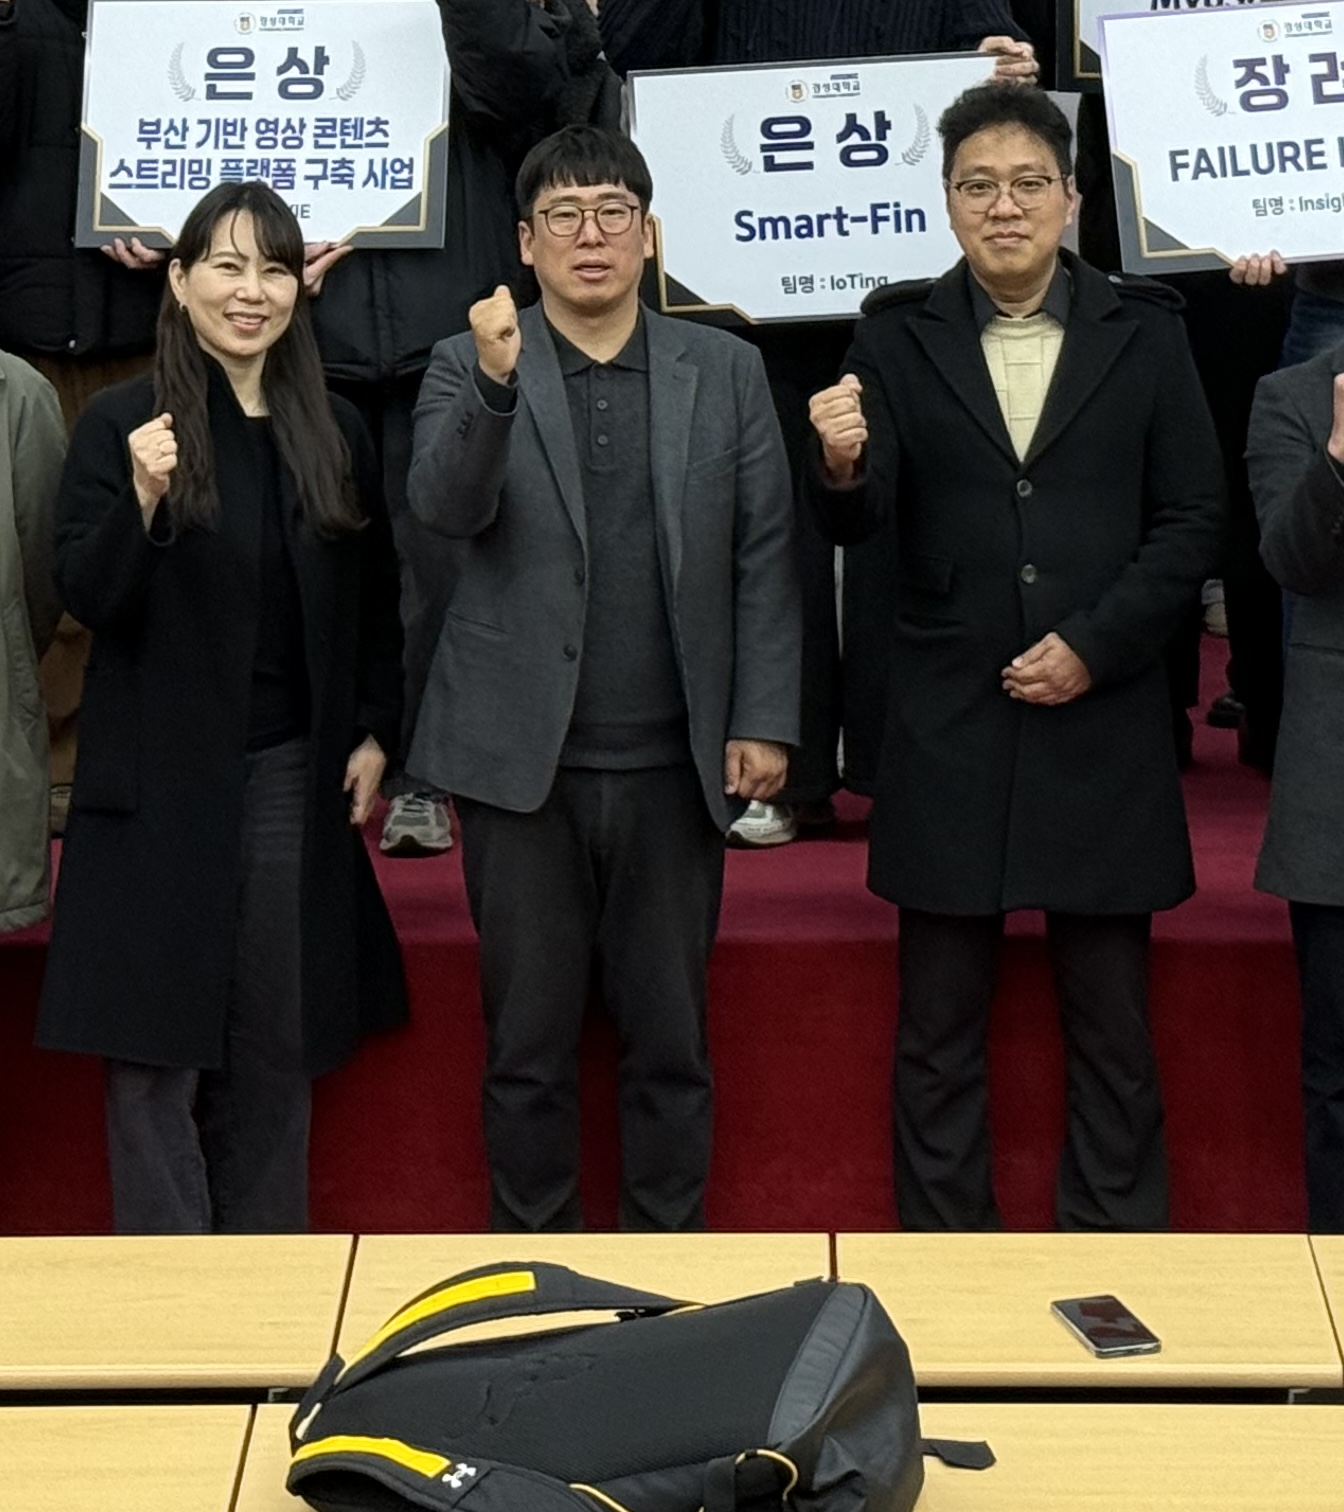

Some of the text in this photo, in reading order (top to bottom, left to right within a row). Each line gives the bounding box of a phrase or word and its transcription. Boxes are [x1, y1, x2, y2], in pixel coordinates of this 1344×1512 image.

[136, 116, 390, 150] 부산 기반 영상 콘텐츠
[108, 157, 212, 190] 스트리밍
[304, 157, 355, 190] 구축
[362, 157, 414, 190] 사업
[1169, 138, 1328, 182] FAILURE
[734, 202, 927, 242] Smart-Fin
[1252, 196, 1285, 217] 팀명
[781, 274, 814, 294] 팀명
